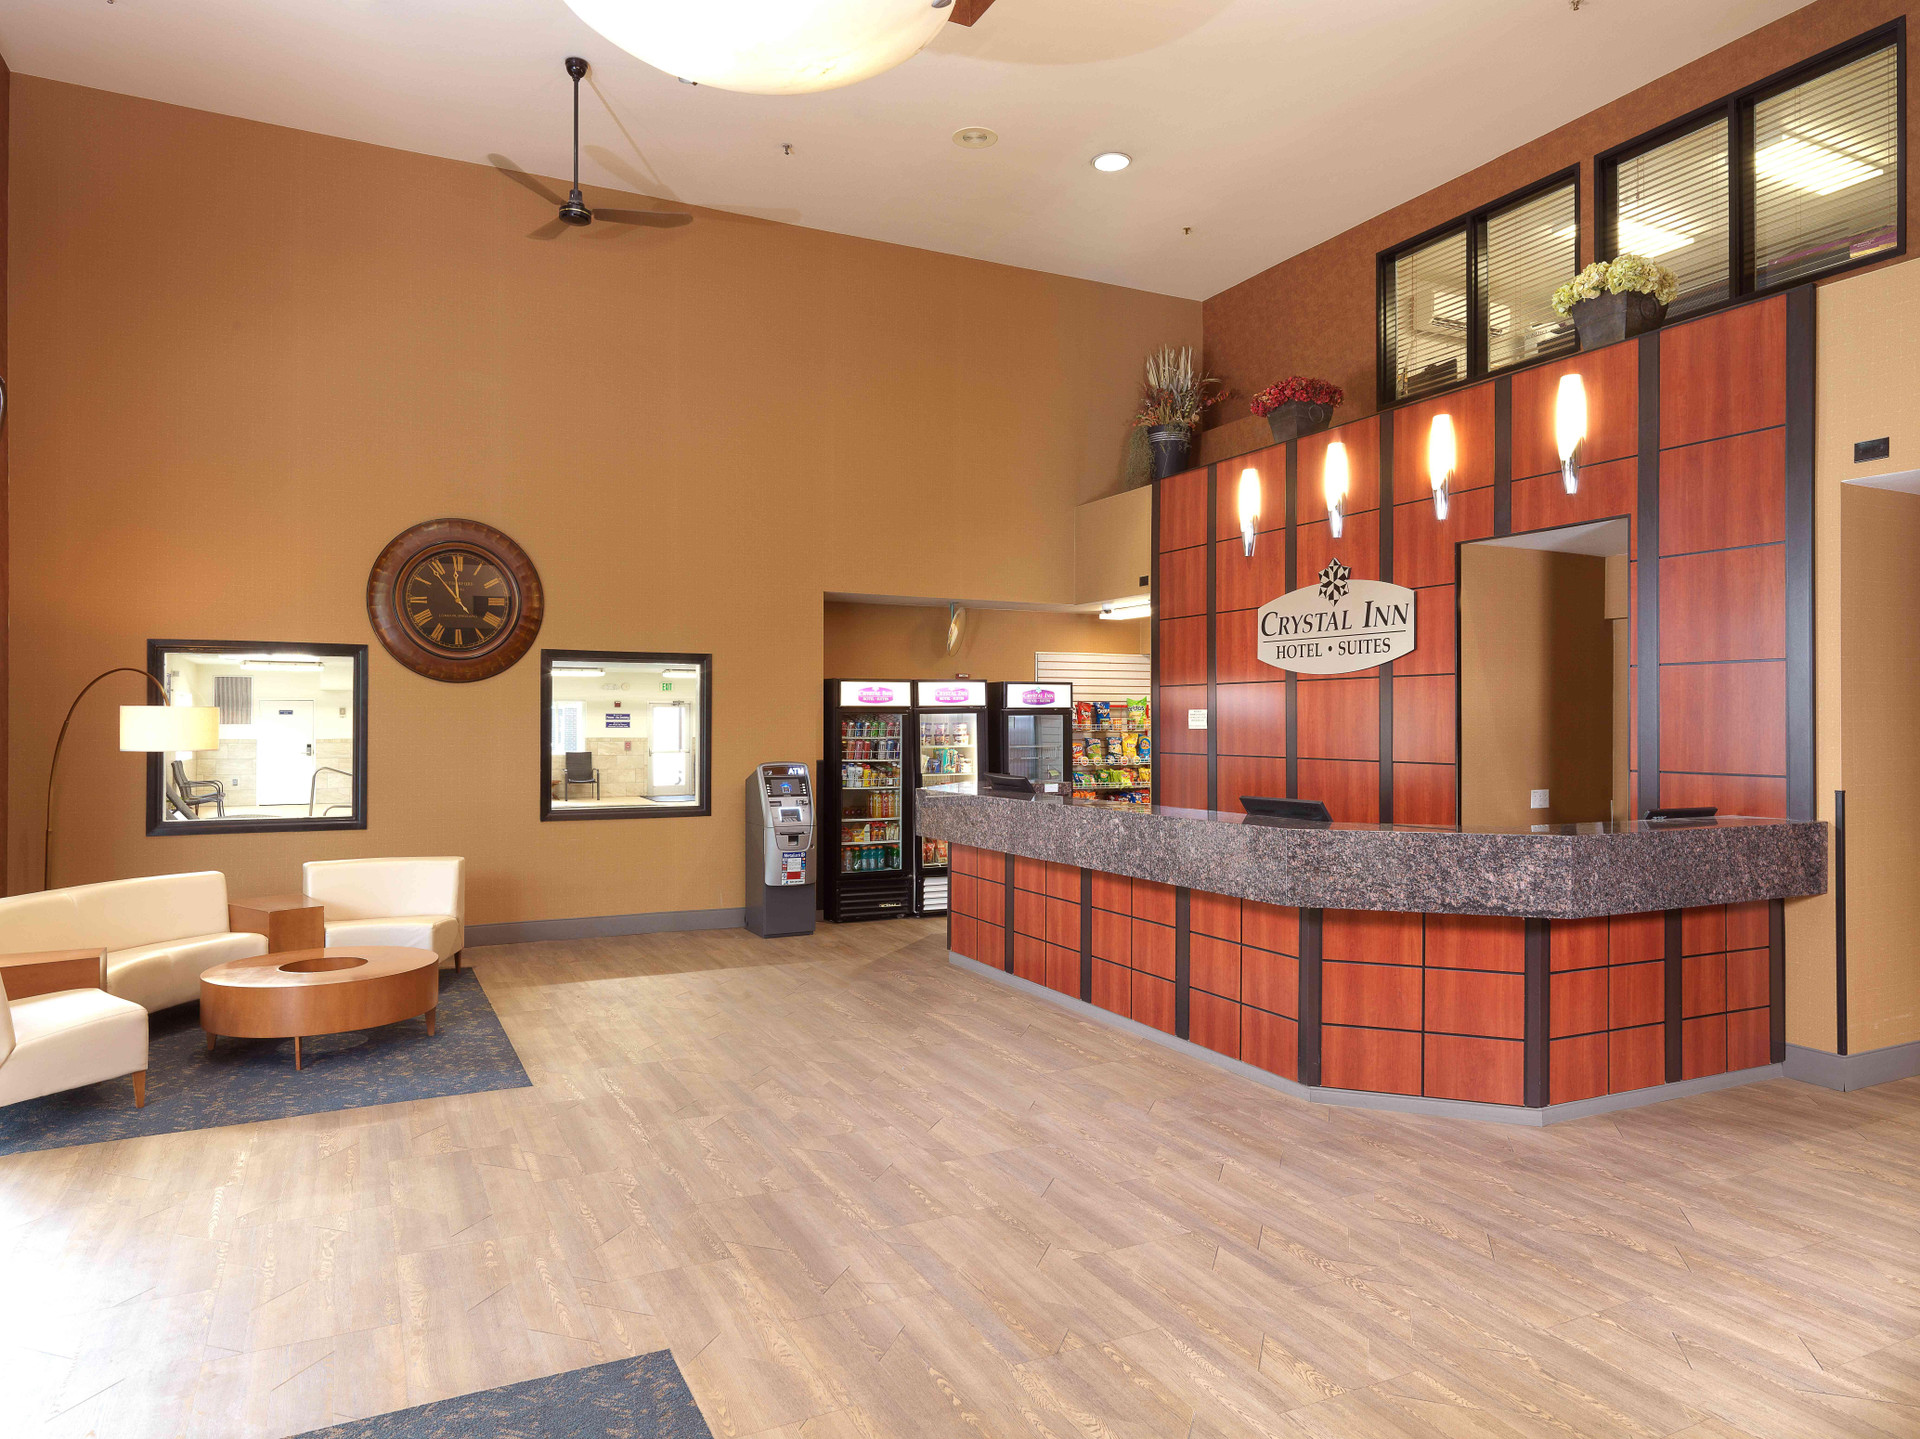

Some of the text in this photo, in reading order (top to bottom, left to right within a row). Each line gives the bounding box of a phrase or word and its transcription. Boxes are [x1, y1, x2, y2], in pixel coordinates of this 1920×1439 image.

[1261, 600, 1410, 637] CRYSTAL INN
[1276, 637, 1391, 659] HOTEL SUITES
[662, 683, 672, 691] EXIT
[788, 767, 805, 776] ATM
